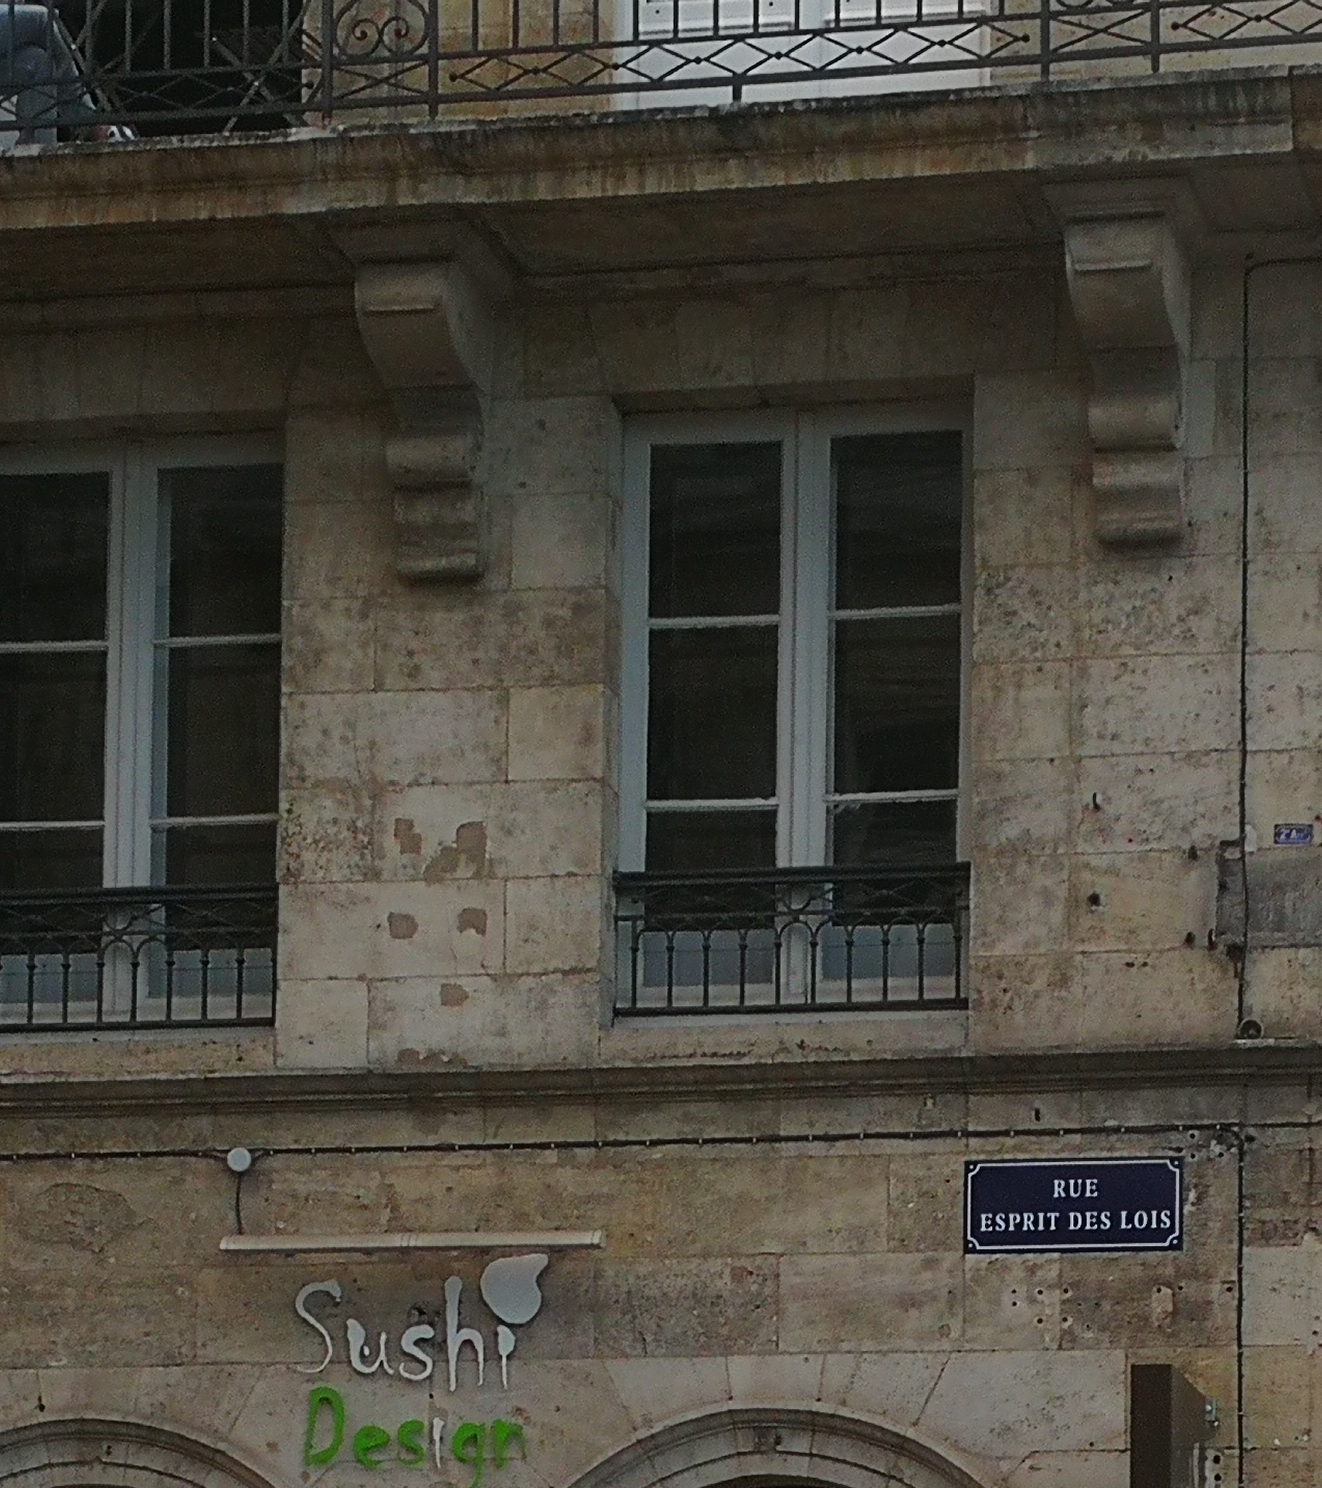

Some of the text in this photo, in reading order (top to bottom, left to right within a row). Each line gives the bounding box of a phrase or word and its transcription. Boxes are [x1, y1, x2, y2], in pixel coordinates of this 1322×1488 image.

[1052, 1178, 1099, 1198] RUE
[980, 1209, 1172, 1232] ESPRIT DES LOIS
[294, 1253, 549, 1392] Sushi
